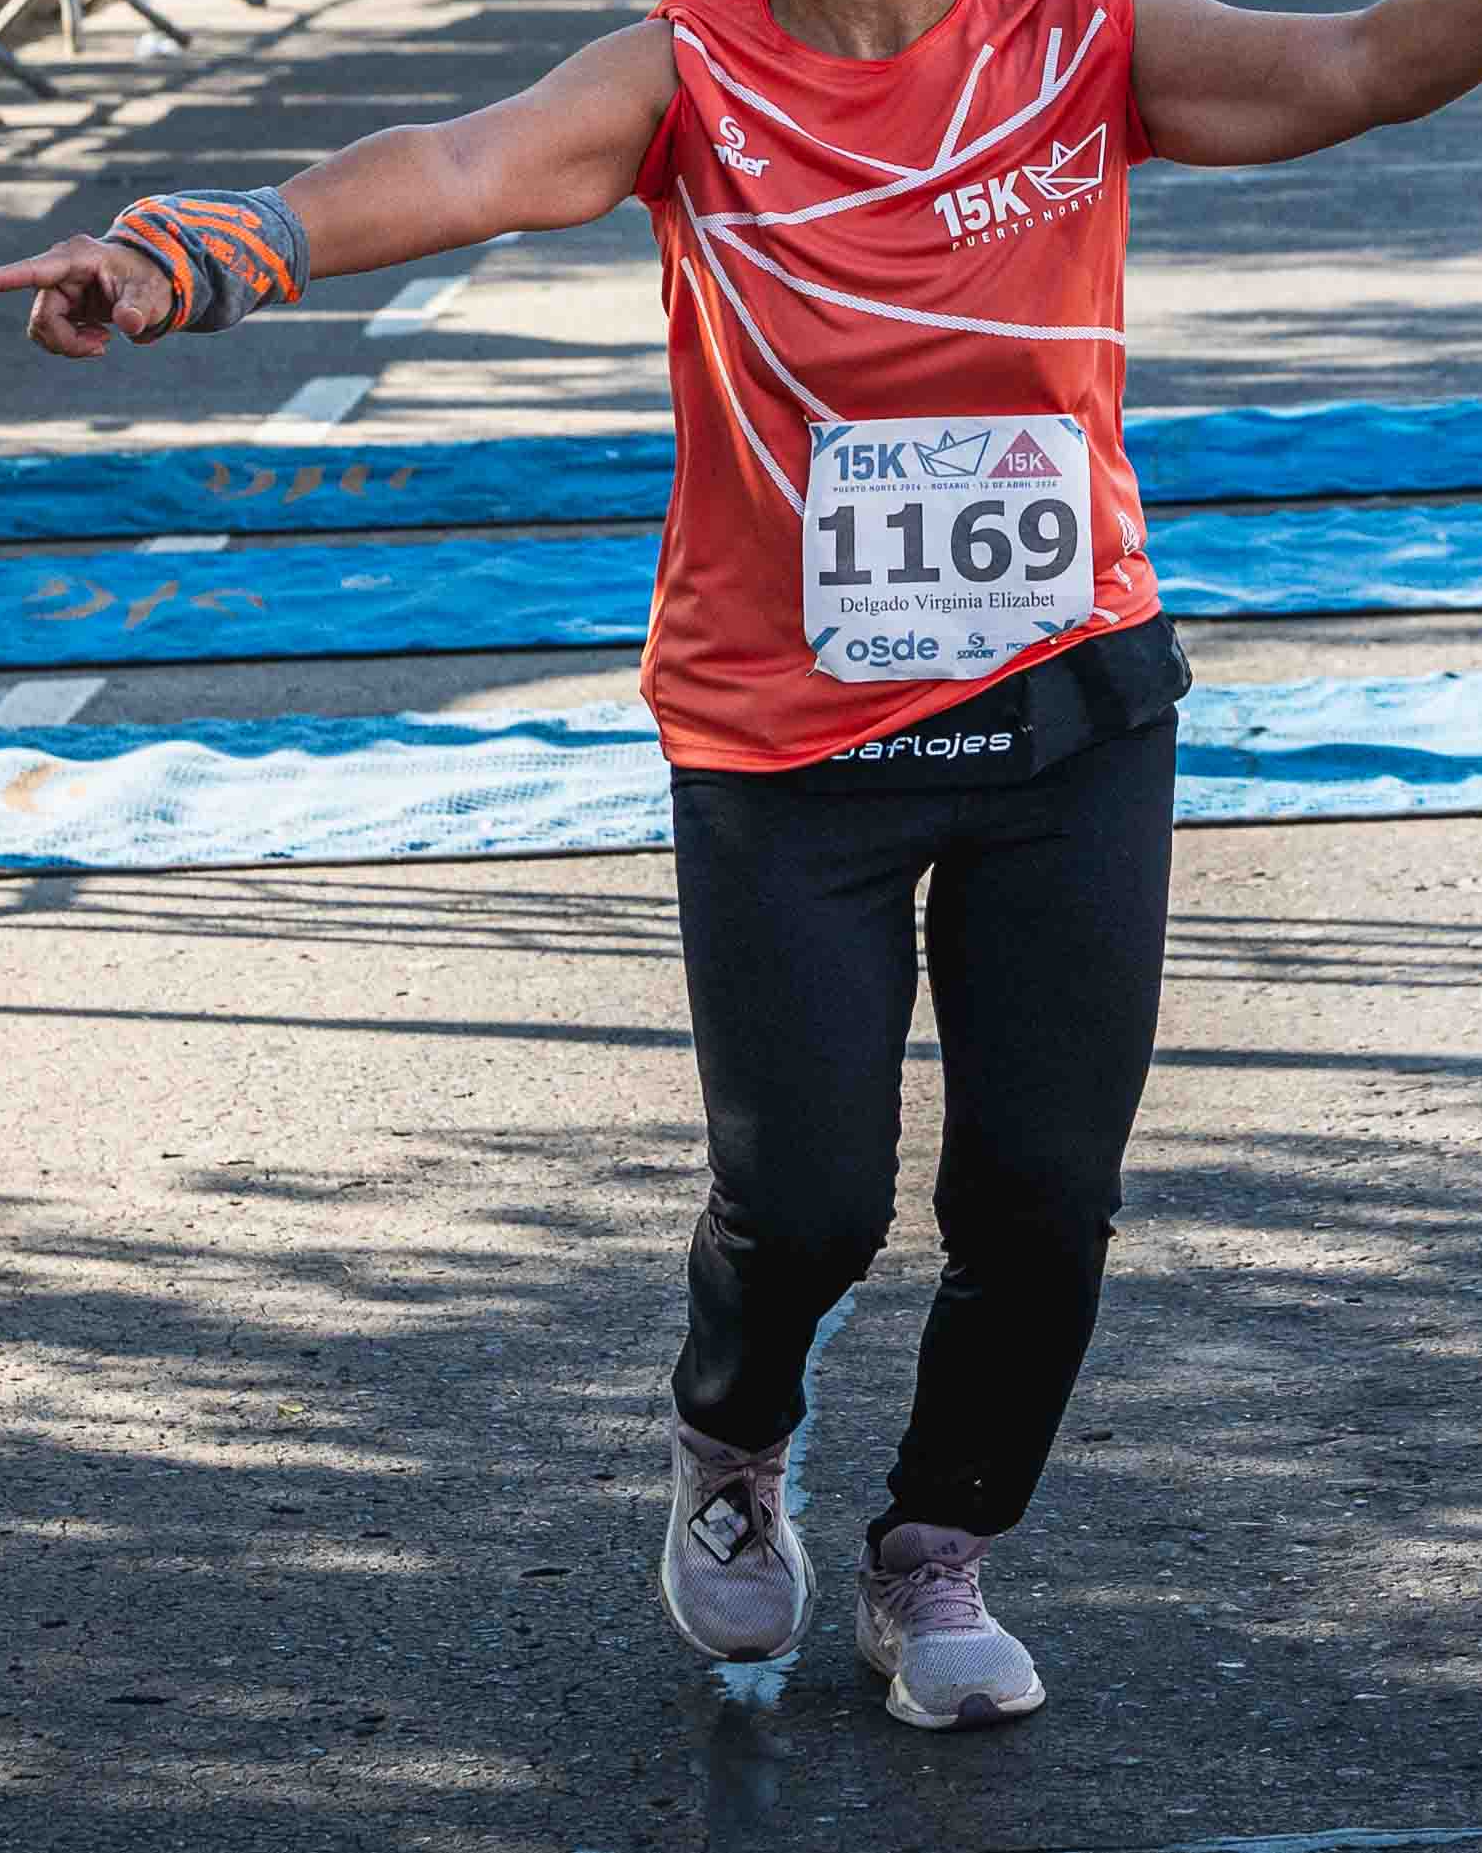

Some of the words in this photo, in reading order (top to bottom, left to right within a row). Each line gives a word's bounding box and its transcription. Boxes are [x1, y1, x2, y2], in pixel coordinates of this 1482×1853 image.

[933, 170, 1031, 238] 15K
[951, 219, 1035, 253] PUERTO
[832, 442, 909, 482] 15K
[1004, 451, 1046, 473] 15K
[832, 484, 867, 494] PUERTO
[869, 483, 898, 493] NORTE
[930, 481, 970, 492] ROSARIO
[818, 498, 1078, 586] 1169
[839, 597, 910, 616] Delgado
[914, 593, 983, 614] Virginia
[988, 591, 1056, 610] Elizabet
[845, 630, 940, 667] osde
